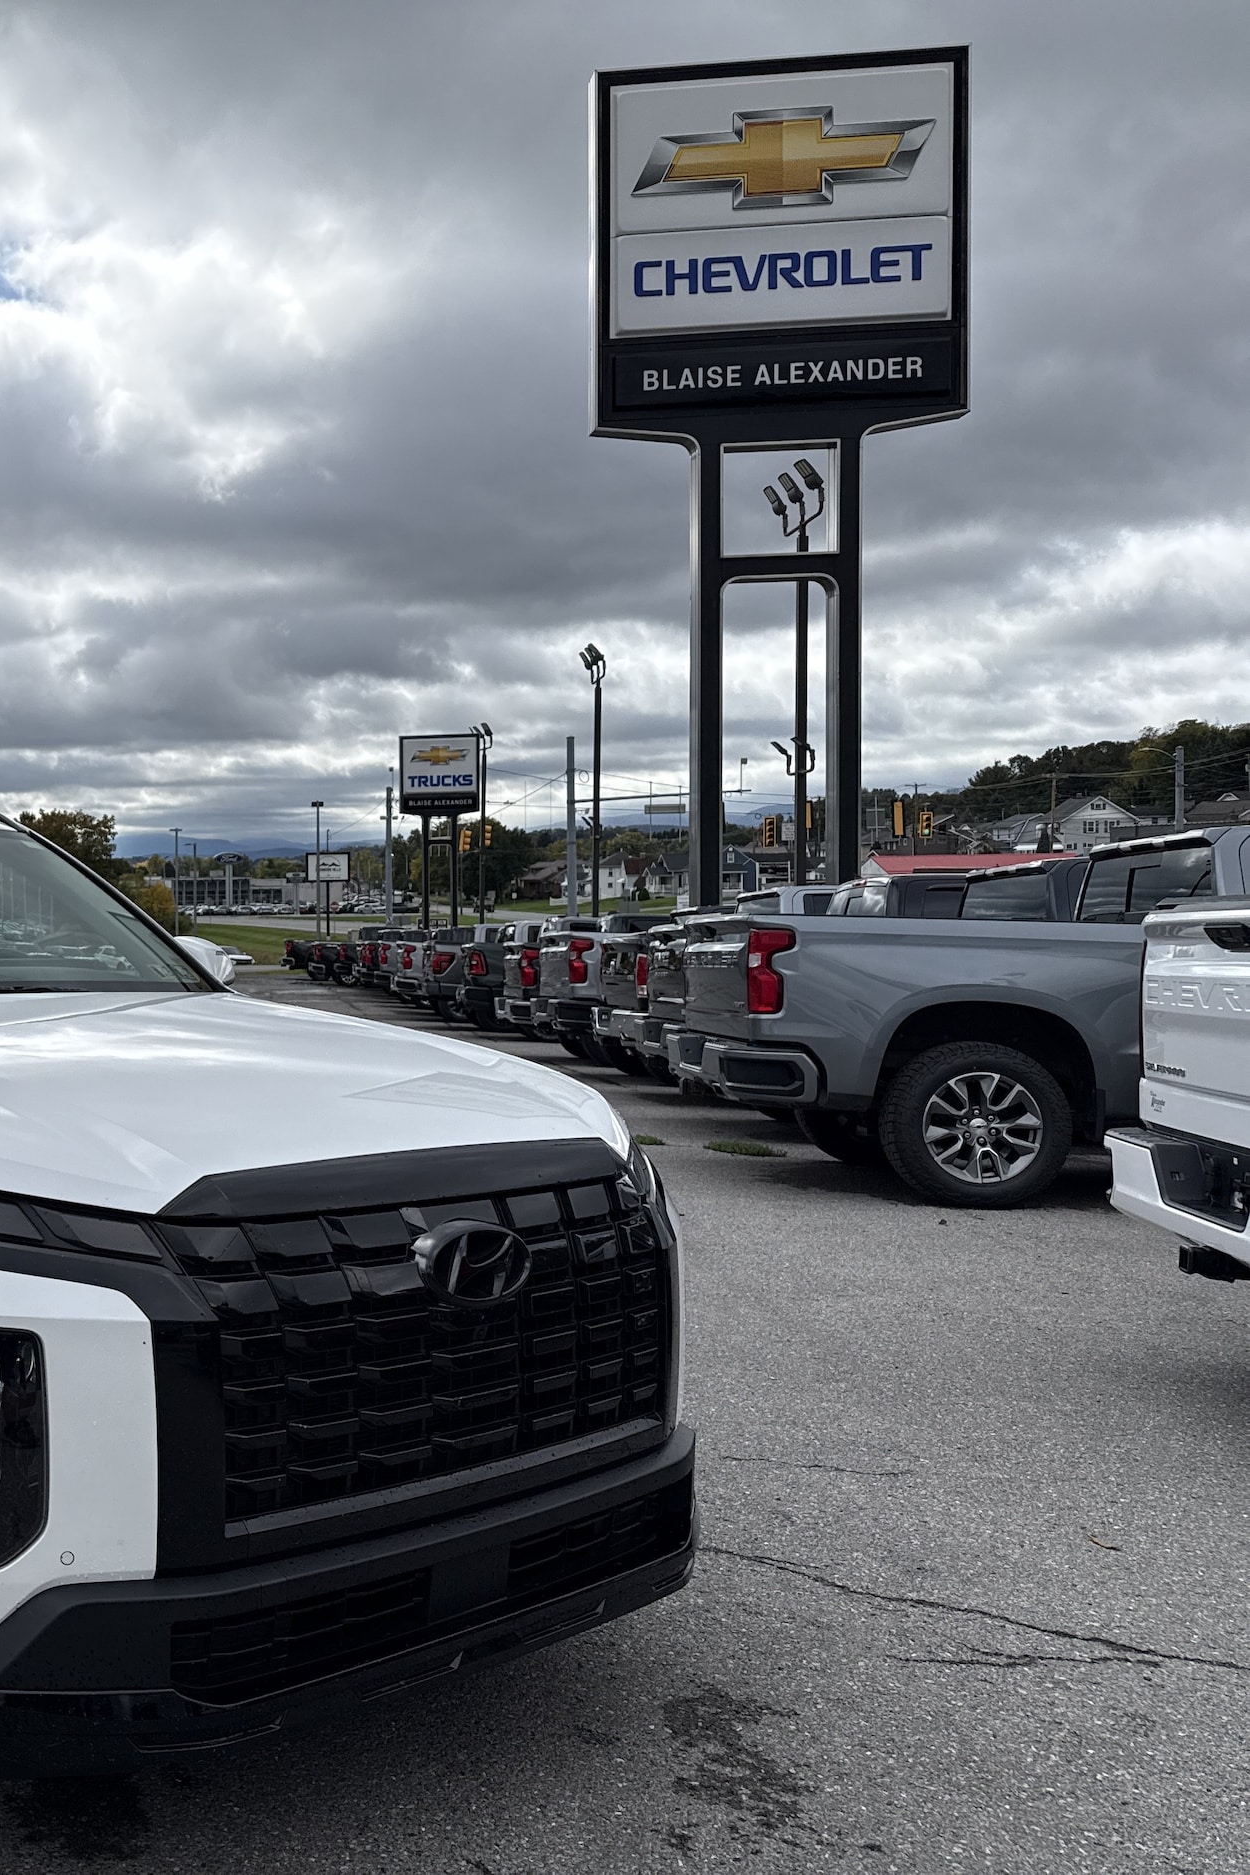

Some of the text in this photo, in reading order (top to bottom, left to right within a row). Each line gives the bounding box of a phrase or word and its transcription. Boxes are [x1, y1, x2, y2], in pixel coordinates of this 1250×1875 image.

[633, 242, 933, 298] CHEVROLET
[642, 356, 924, 392] BLAISE ALEXANDER
[407, 774, 473, 787] TRUCKS
[433, 798, 473, 806] ALEXANDER
[219, 854, 239, 863] Ford
[1145, 979, 1250, 1012] CHEVR
